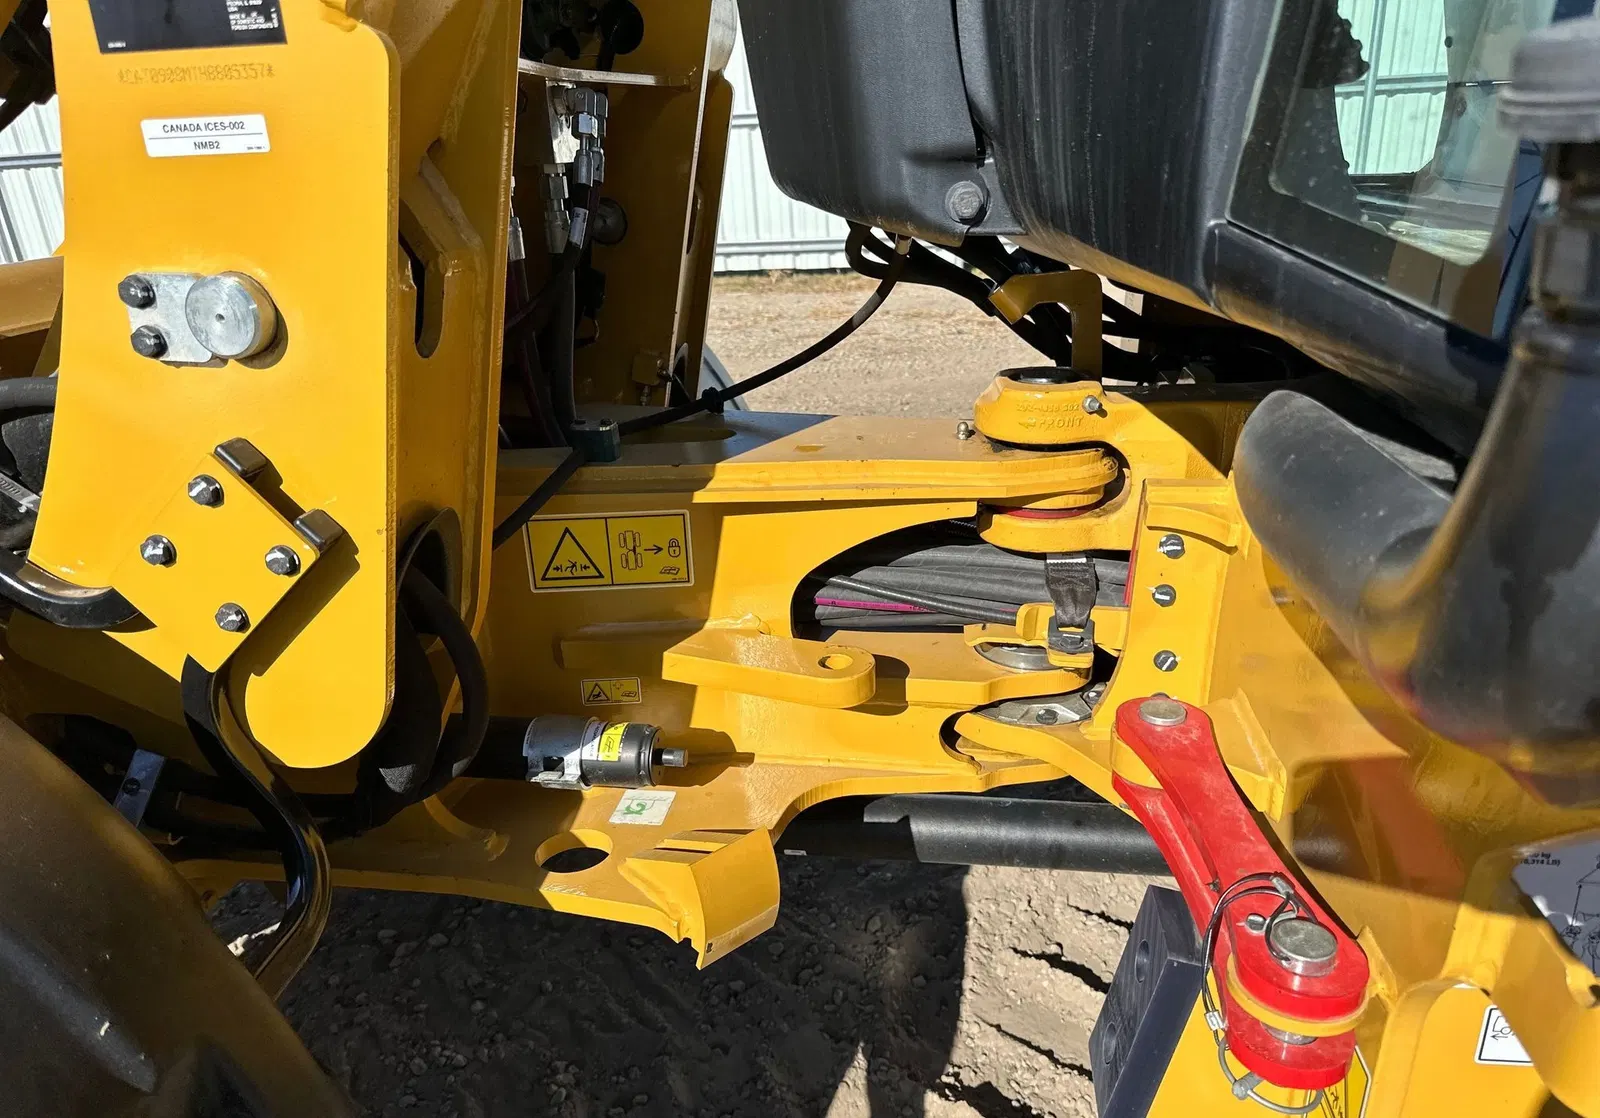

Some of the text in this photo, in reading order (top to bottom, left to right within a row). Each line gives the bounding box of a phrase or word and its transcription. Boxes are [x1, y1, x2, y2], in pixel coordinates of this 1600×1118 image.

[162, 121, 245, 133] CANADA ICES-002
[194, 141, 220, 150] NMB2
[1039, 416, 1084, 430] FRONT
